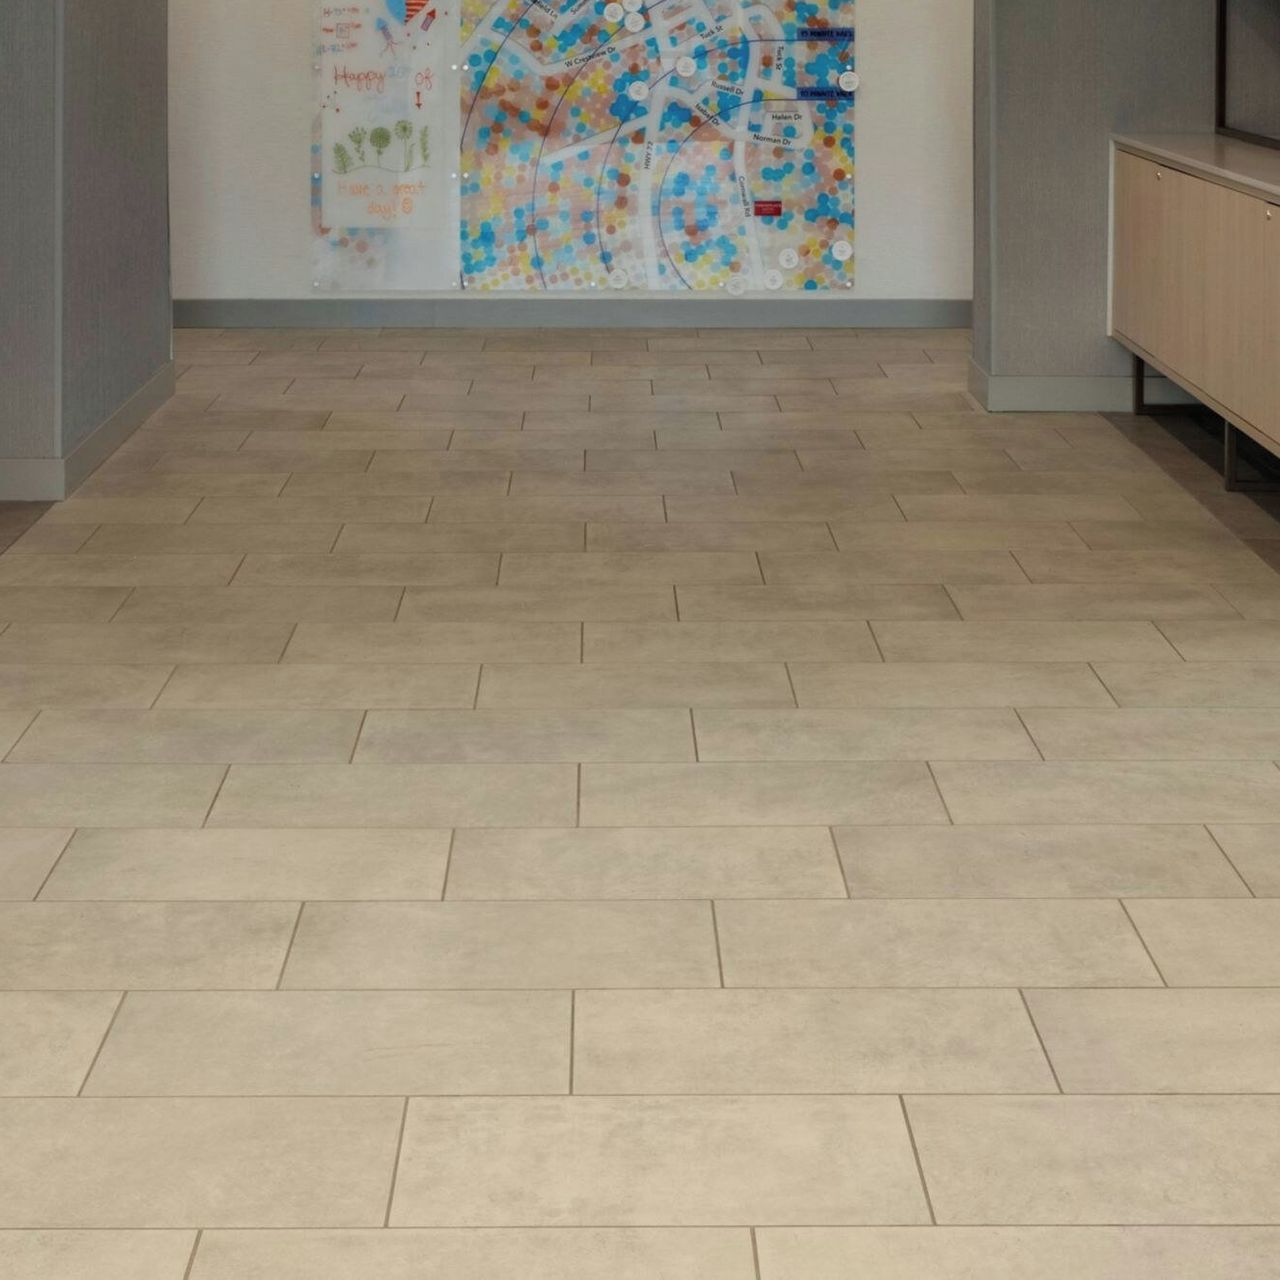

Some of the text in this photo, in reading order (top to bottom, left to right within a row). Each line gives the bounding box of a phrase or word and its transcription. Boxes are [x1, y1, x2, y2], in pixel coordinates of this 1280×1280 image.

[334, 64, 384, 93] Happy
[712, 118, 720, 126] Dr
[753, 134, 781, 144] Norman
[644, 151, 652, 169] HWY
[744, 208, 752, 217] Rd
